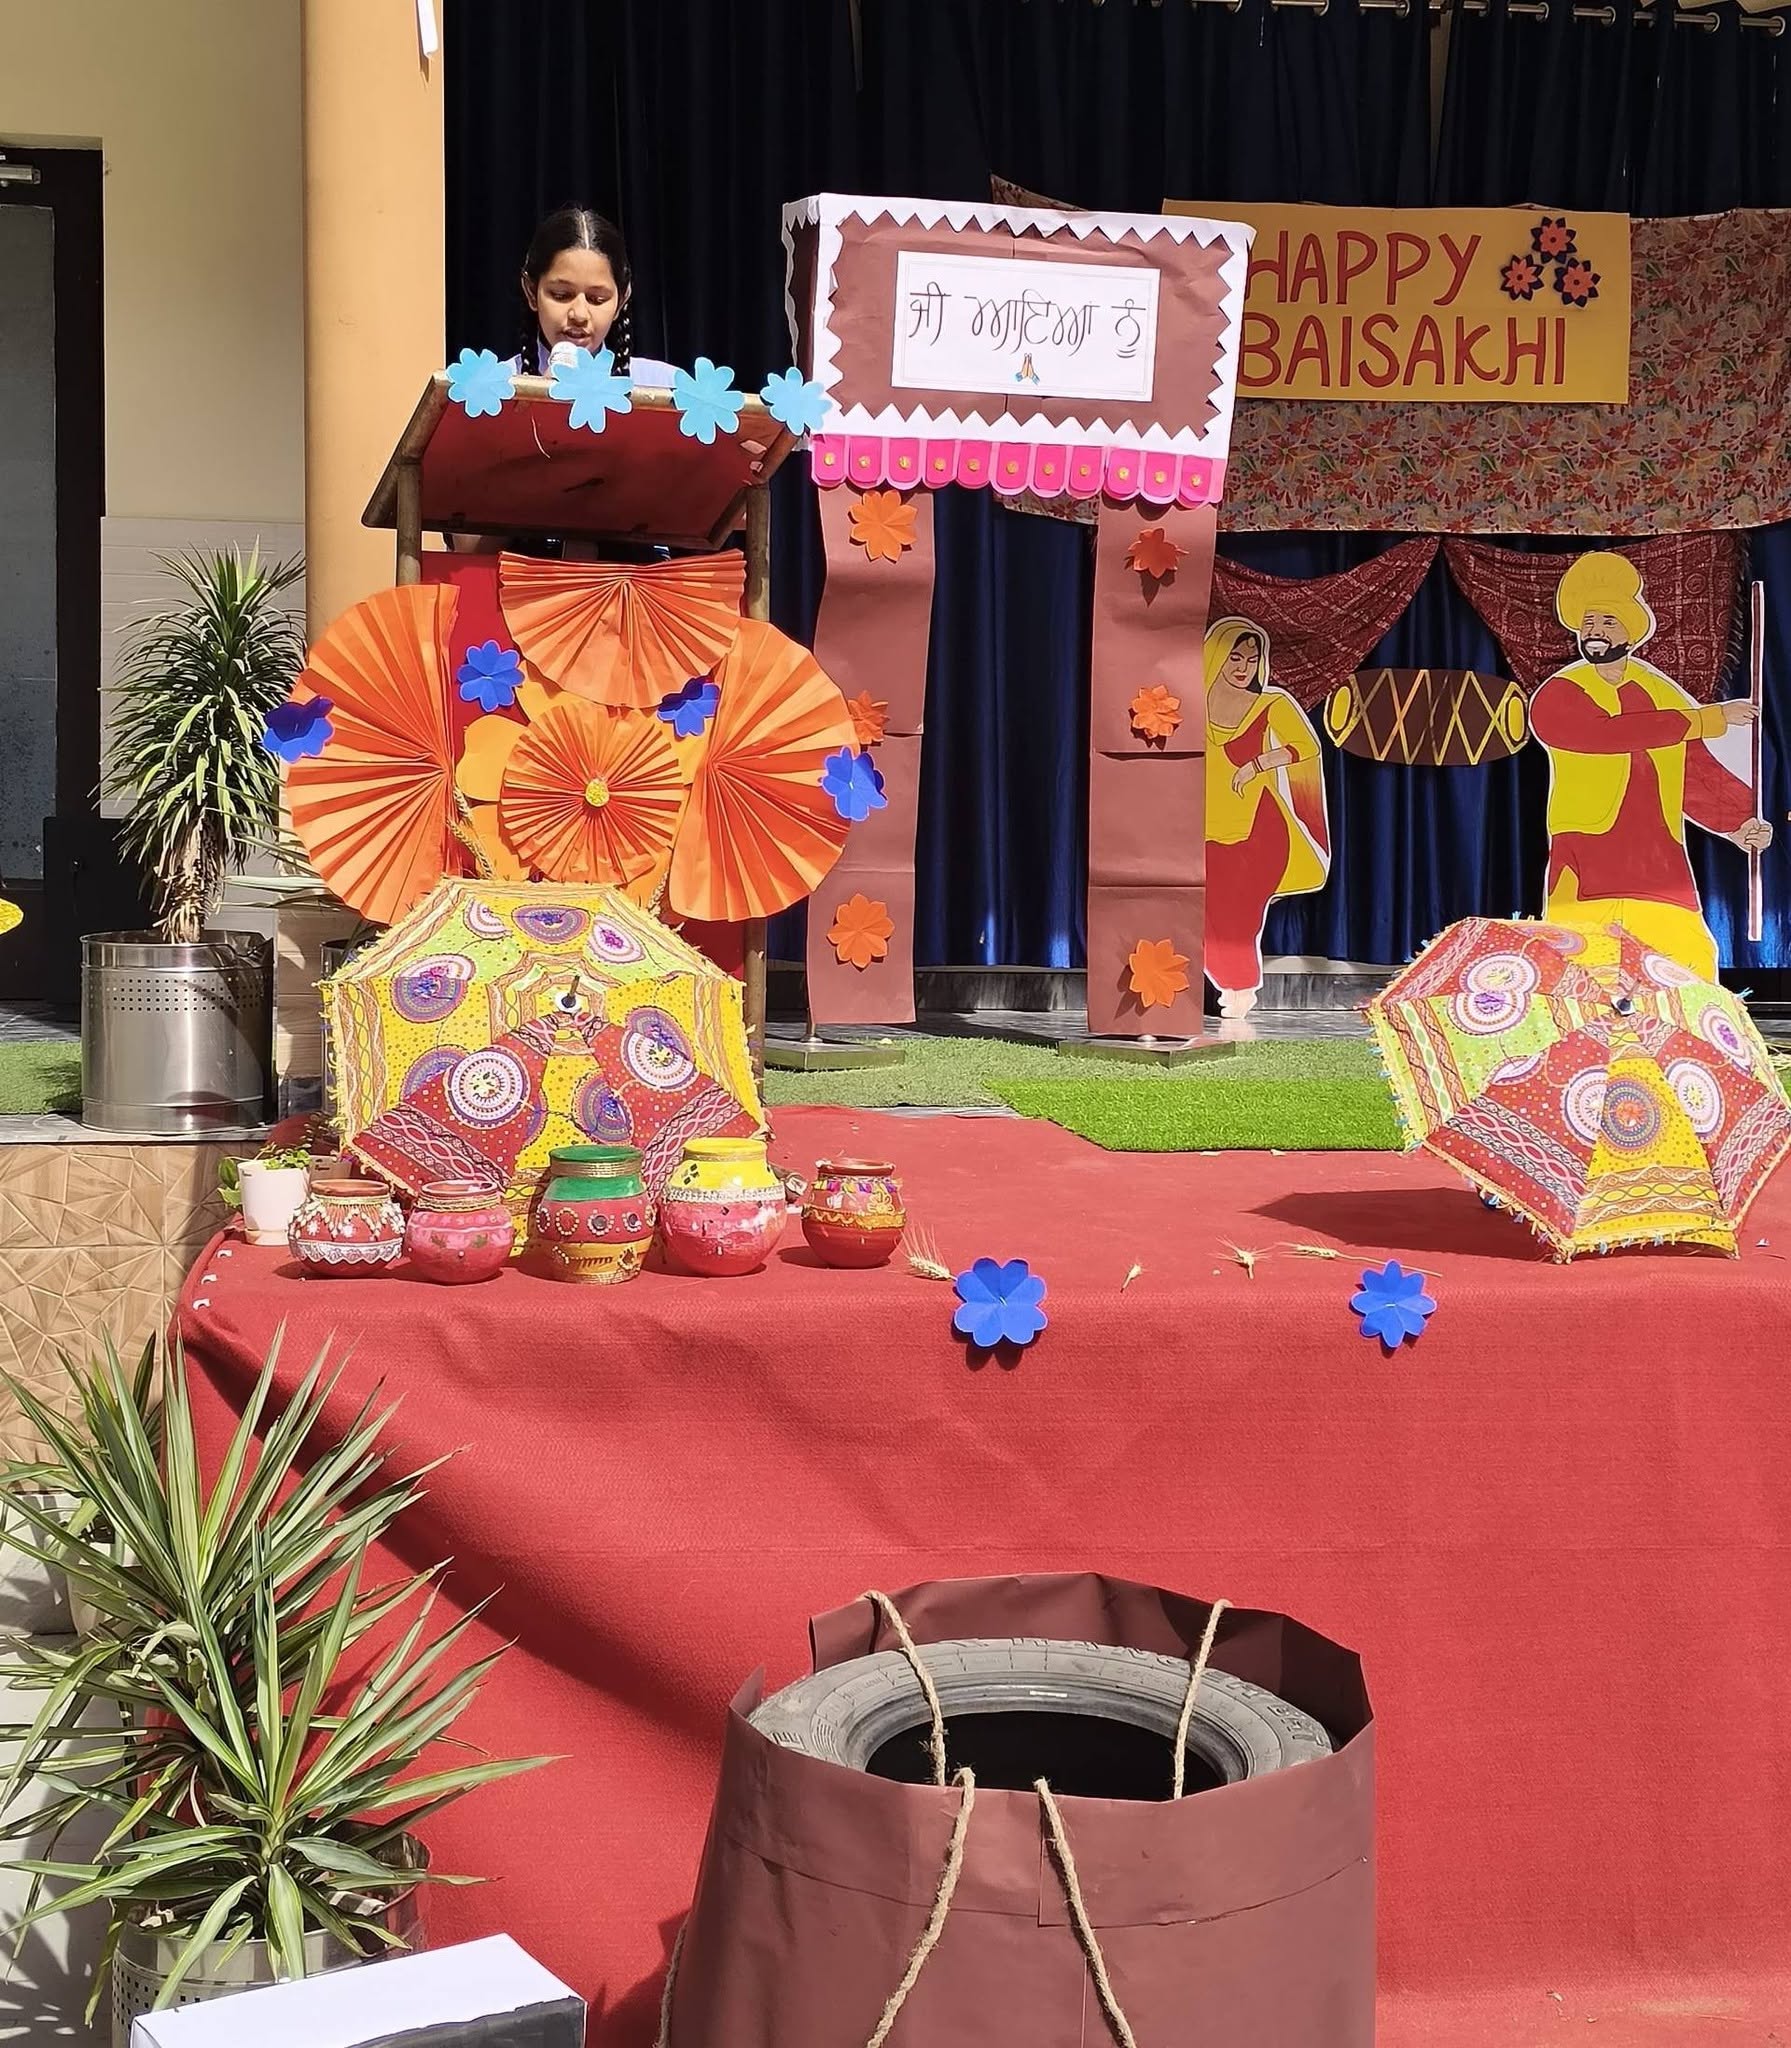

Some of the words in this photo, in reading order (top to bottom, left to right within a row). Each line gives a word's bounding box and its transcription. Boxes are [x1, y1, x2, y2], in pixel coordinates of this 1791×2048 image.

[1244, 230, 1482, 307] HAPPY
[908, 281, 952, 347] ਜੀ
[1238, 312, 1566, 389] BAISAKHI
